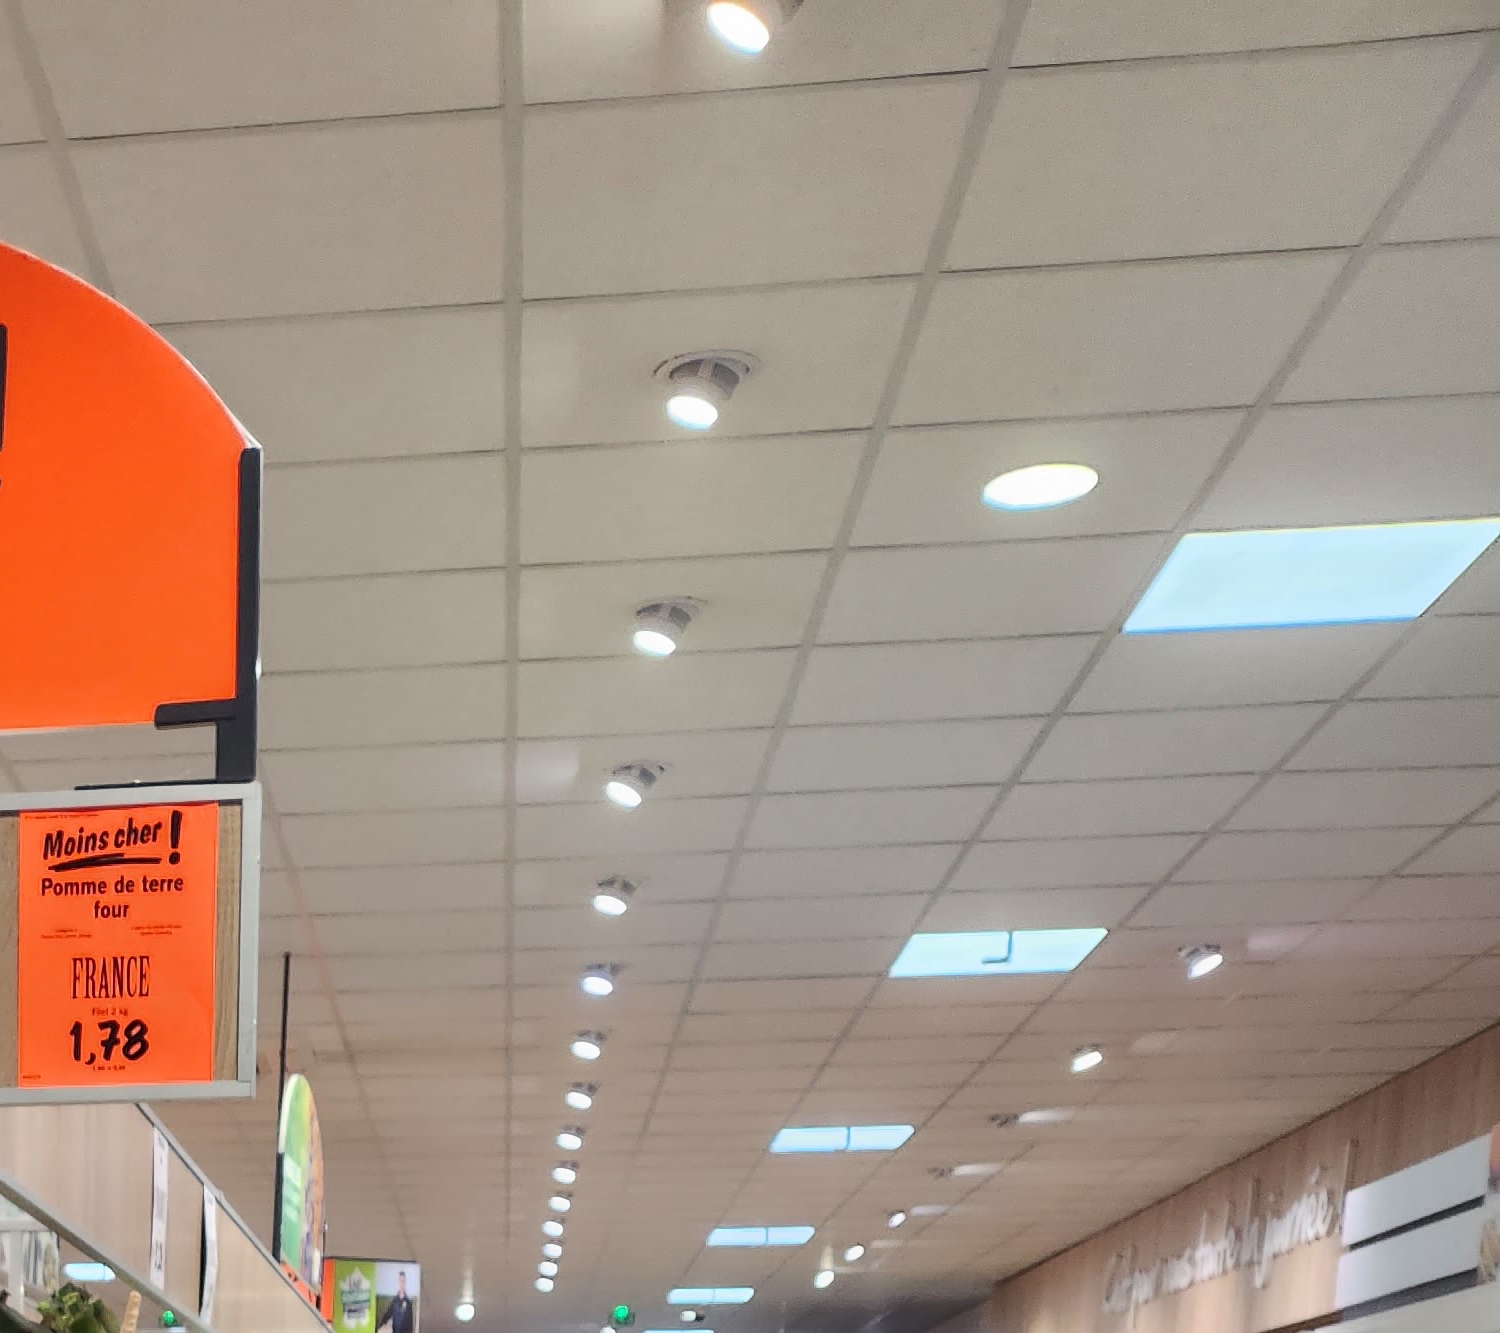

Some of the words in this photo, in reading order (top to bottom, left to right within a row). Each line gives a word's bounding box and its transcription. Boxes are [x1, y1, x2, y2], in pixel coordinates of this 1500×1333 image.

[43, 827, 109, 860] Moins
[114, 818, 162, 849] cher
[169, 810, 182, 864] !
[41, 877, 107, 896] Pomme
[114, 875, 135, 893] de
[142, 876, 184, 893] terre
[94, 901, 130, 918] four
[71, 956, 150, 1000] FRANCE
[69, 1019, 149, 1065] 1,78
